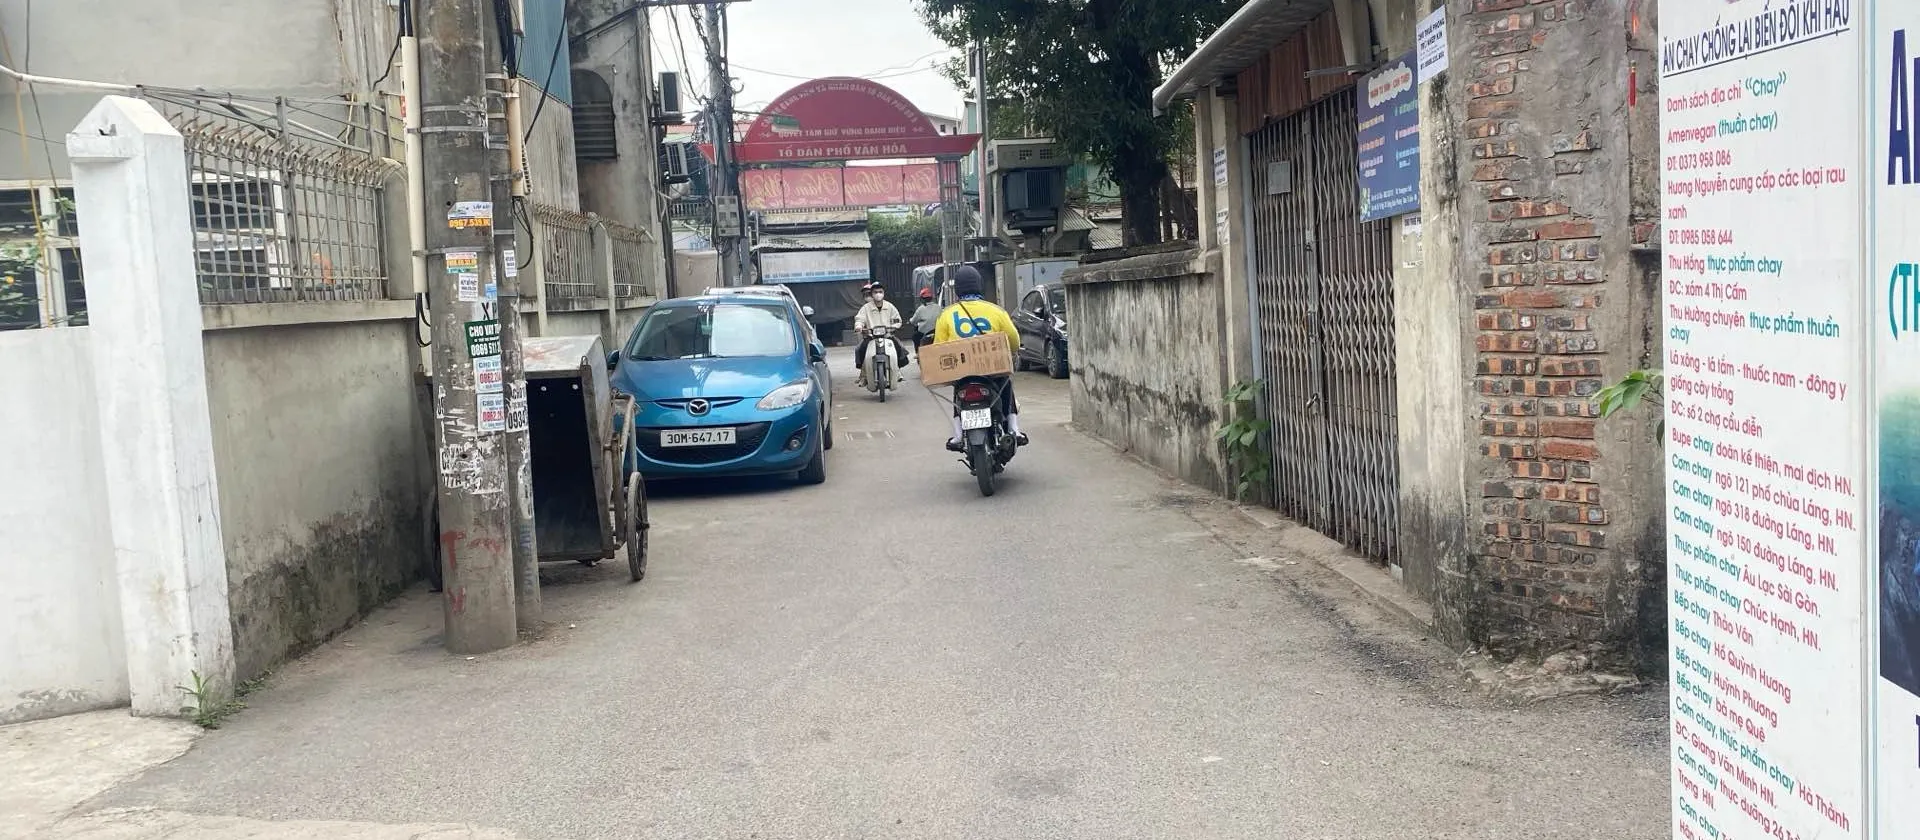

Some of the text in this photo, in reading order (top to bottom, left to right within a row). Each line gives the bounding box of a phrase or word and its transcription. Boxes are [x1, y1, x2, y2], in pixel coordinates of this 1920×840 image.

[1663, 36, 1674, 72] ĂN
[1677, 34, 1699, 66] CHAY
[1702, 14, 1736, 63] CHỐNG
[1755, 1, 1777, 48] BIẾN
[1667, 94, 1687, 112] Danh
[1690, 92, 1709, 107] sách
[1712, 86, 1725, 107] địa
[1728, 80, 1741, 100] chỉ
[1668, 124, 1716, 143] Amenvegan
[1750, 112, 1777, 132] chay)
[1679, 153, 1697, 170] 0373
[1700, 152, 1714, 168] 958
[1716, 150, 1731, 166] 086
[1730, 176, 1753, 193] cung
[1756, 169, 1775, 191] cấp
[1779, 168, 1799, 187] các
[1803, 167, 1823, 190] loại
[1826, 167, 1845, 183] rau
[1668, 205, 1687, 219] xanh
[1681, 230, 1699, 245] 0985
[1702, 230, 1716, 244] 058
[1718, 230, 1733, 245] 644
[1669, 255, 1682, 269] Thu
[1707, 255, 1726, 274] thực
[1729, 252, 1755, 274] phẩm
[1758, 258, 1783, 277] chay
[1669, 280, 1683, 295] ĐC:
[1705, 284, 1710, 297] 4
[1712, 283, 1723, 302] Thị
[1725, 282, 1747, 300] Cấm
[468, 325, 483, 337] CHO
[953, 311, 992, 338] be
[1670, 304, 1682, 320] Thu
[1713, 311, 1745, 329] chuyên
[1750, 312, 1770, 332] thực
[1774, 311, 1804, 334] phẩm
[1808, 314, 1840, 337] thuần
[1670, 325, 1690, 344] chay
[1681, 354, 1700, 372] xông
[1743, 362, 1770, 383] thuốc
[1773, 371, 1795, 388] nam
[1807, 374, 1836, 399] đông
[1839, 381, 1847, 400] y
[1694, 380, 1710, 398] cây
[1687, 404, 1696, 419] số
[1698, 407, 1702, 421] 2
[1693, 436, 1714, 456] chay
[1741, 447, 1753, 465] kế
[1784, 463, 1803, 482] mai
[1807, 468, 1831, 491] dịch
[1835, 475, 1855, 497] HN.
[1692, 461, 1712, 483] chay
[1735, 475, 1749, 494] 121
[1752, 483, 1771, 502] phố
[1774, 491, 1799, 511] chùa
[1836, 509, 1856, 531] HN.
[1675, 534, 1692, 556] Thực
[1720, 557, 1741, 582] chay
[1743, 564, 1755, 587] Âu
[1759, 575, 1775, 597] Lạc
[1778, 583, 1793, 604] Sài
[1674, 589, 1690, 610] Bếp
[1691, 599, 1711, 622] chay
[1675, 618, 1690, 640] Bếp
[1691, 630, 1712, 654] chay
[1676, 646, 1691, 668] Bếp
[1692, 659, 1712, 684] chay
[1676, 670, 1691, 692] Bếp
[1693, 683, 1712, 708] chay
[1730, 709, 1744, 730] mẹ
[1692, 734, 1716, 765] Giang
[1718, 751, 1735, 776] Văn
[1737, 766, 1758, 794] Minh
[1761, 783, 1777, 809] HN.
[1698, 764, 1718, 790] chay
[1720, 727, 1739, 751] thực
[1770, 765, 1794, 794] chay
[1816, 794, 1850, 832] Thành
